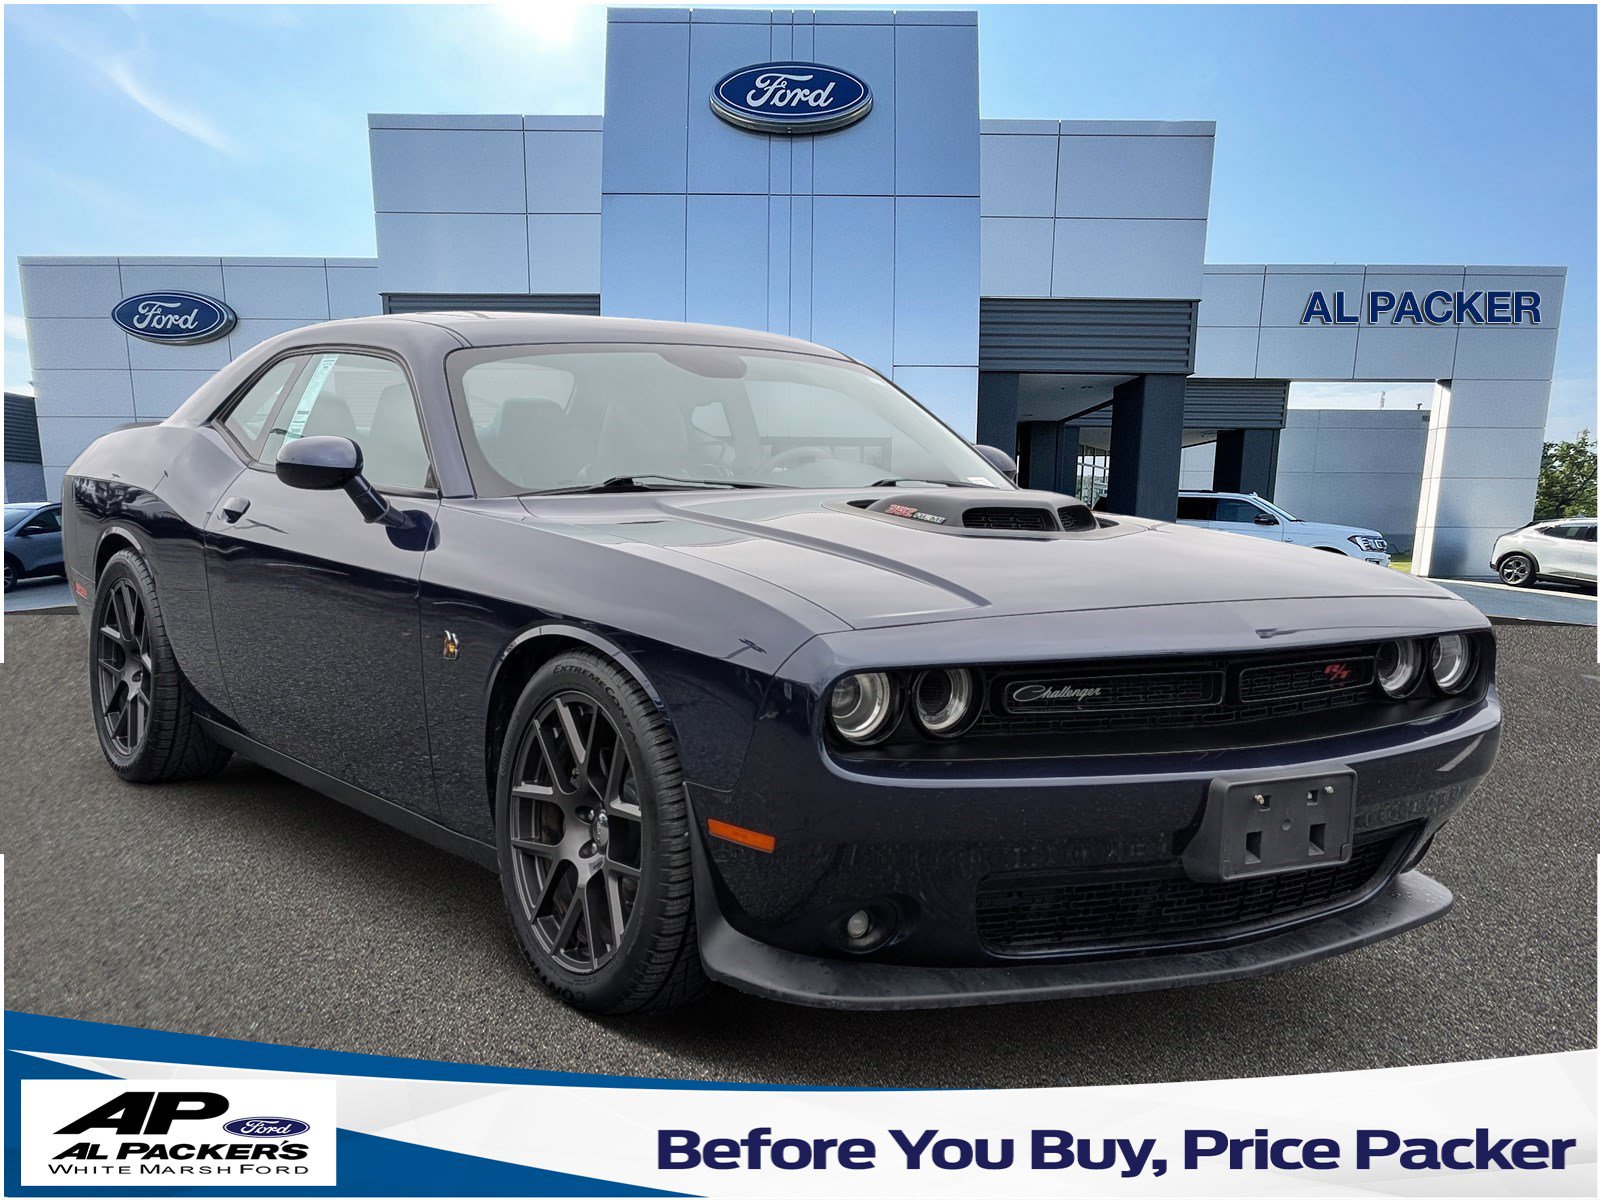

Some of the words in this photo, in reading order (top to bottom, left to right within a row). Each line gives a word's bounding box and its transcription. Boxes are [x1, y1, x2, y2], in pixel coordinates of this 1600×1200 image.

[746, 73, 836, 107] Ford
[133, 301, 198, 329] Ford
[1302, 290, 1359, 324] AL
[1368, 290, 1542, 325] PACKER
[1324, 662, 1349, 681] R/T
[1013, 684, 1102, 702] Challenger
